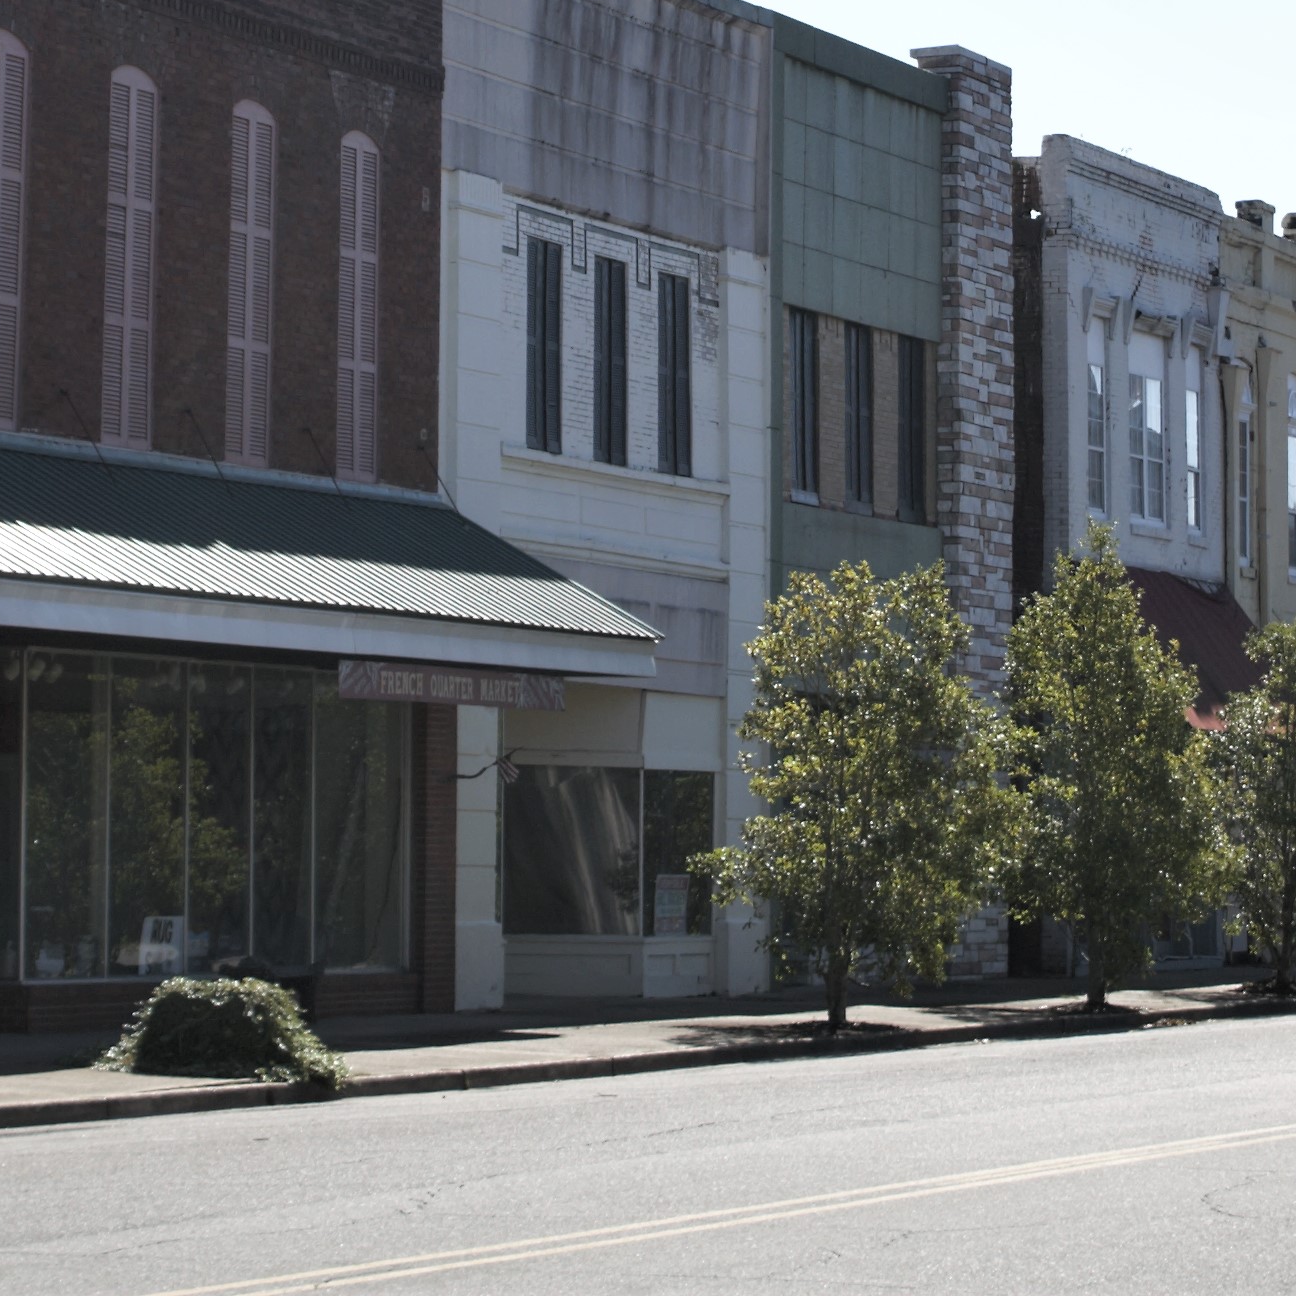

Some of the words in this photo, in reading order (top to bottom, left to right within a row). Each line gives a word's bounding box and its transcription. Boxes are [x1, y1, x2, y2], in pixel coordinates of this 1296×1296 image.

[380, 670, 424, 696] FRENCH
[430, 673, 474, 700] QUARTER
[480, 678, 521, 703] MARKET
